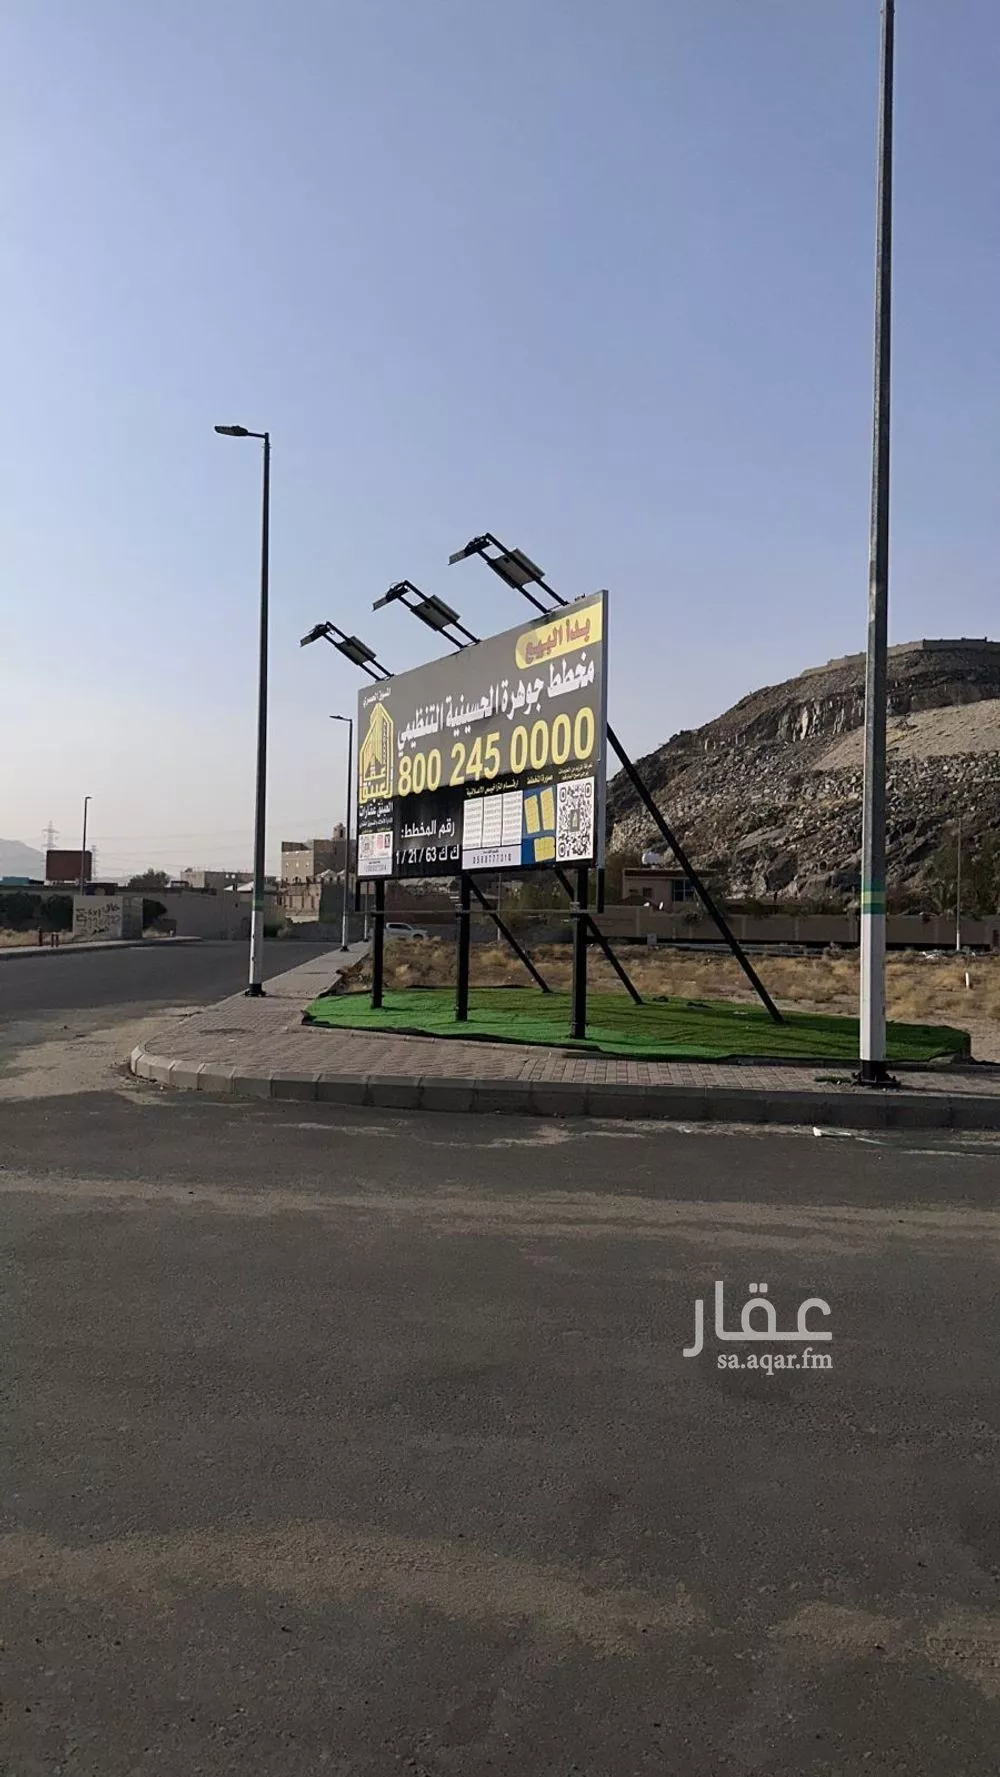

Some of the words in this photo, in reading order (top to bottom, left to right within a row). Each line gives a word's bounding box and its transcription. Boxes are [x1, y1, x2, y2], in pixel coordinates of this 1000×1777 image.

[525, 625, 563, 665] البيع
[566, 618, 591, 642] بدأ
[547, 652, 595, 698] مخطط
[501, 678, 544, 720] جوهرة
[397, 701, 444, 757] التنظيمي
[398, 749, 441, 796] 800
[450, 732, 500, 787] 245
[510, 707, 595, 774] 0000
[439, 818, 455, 838] رقم
[425, 846, 437, 862] 63
